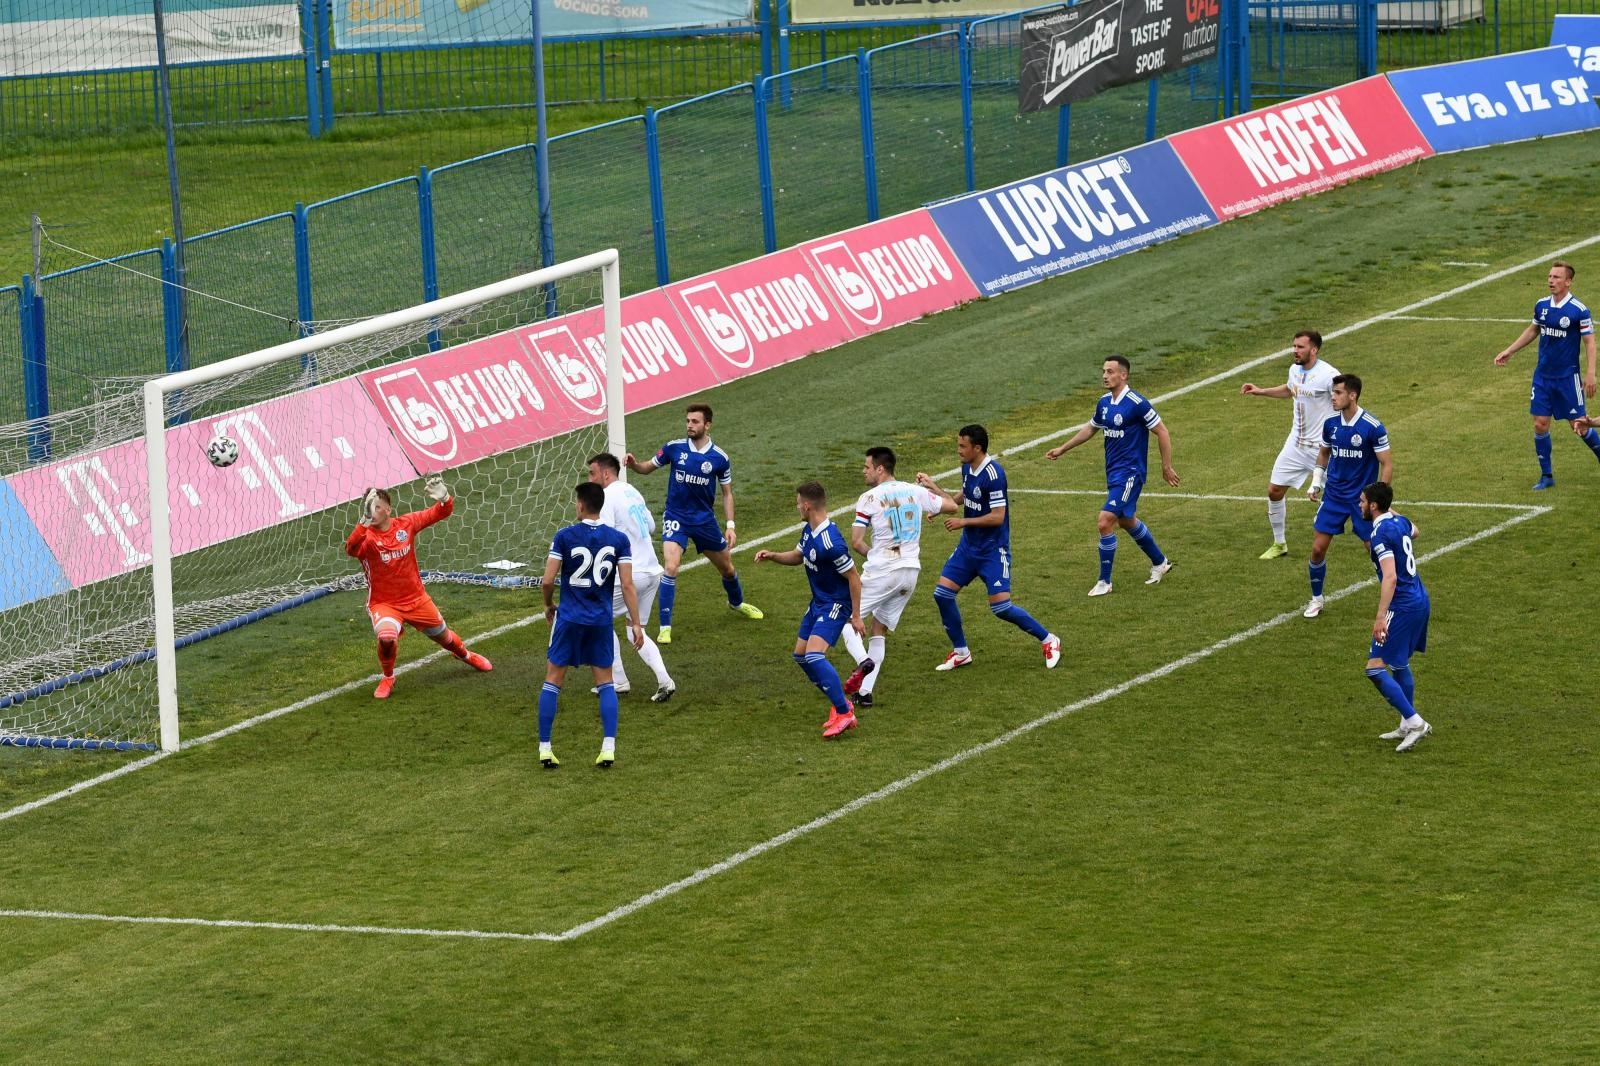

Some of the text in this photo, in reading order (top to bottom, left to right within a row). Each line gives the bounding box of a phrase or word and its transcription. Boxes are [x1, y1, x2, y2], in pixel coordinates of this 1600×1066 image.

[614, 6, 648, 18] SOKA
[1131, 17, 1172, 47] TASTE OF
[1182, 18, 1217, 50] nutrition
[1051, 18, 1119, 82] PowerBar
[1135, 48, 1166, 74] SPORT.
[1421, 92, 1508, 126] Eva.
[1551, 76, 1589, 106] sr
[858, 234, 953, 301] BELUPO
[730, 273, 830, 343] BELUPO
[1546, 327, 1567, 338] BELUPO
[432, 360, 545, 433] BELUPO
[1338, 448, 1363, 459] BELUPO
[685, 474, 710, 486] BELUPO
[665, 520, 680, 532] 30
[883, 504, 921, 542] 19
[569, 546, 615, 588] 26
[1402, 535, 1416, 577] 8
